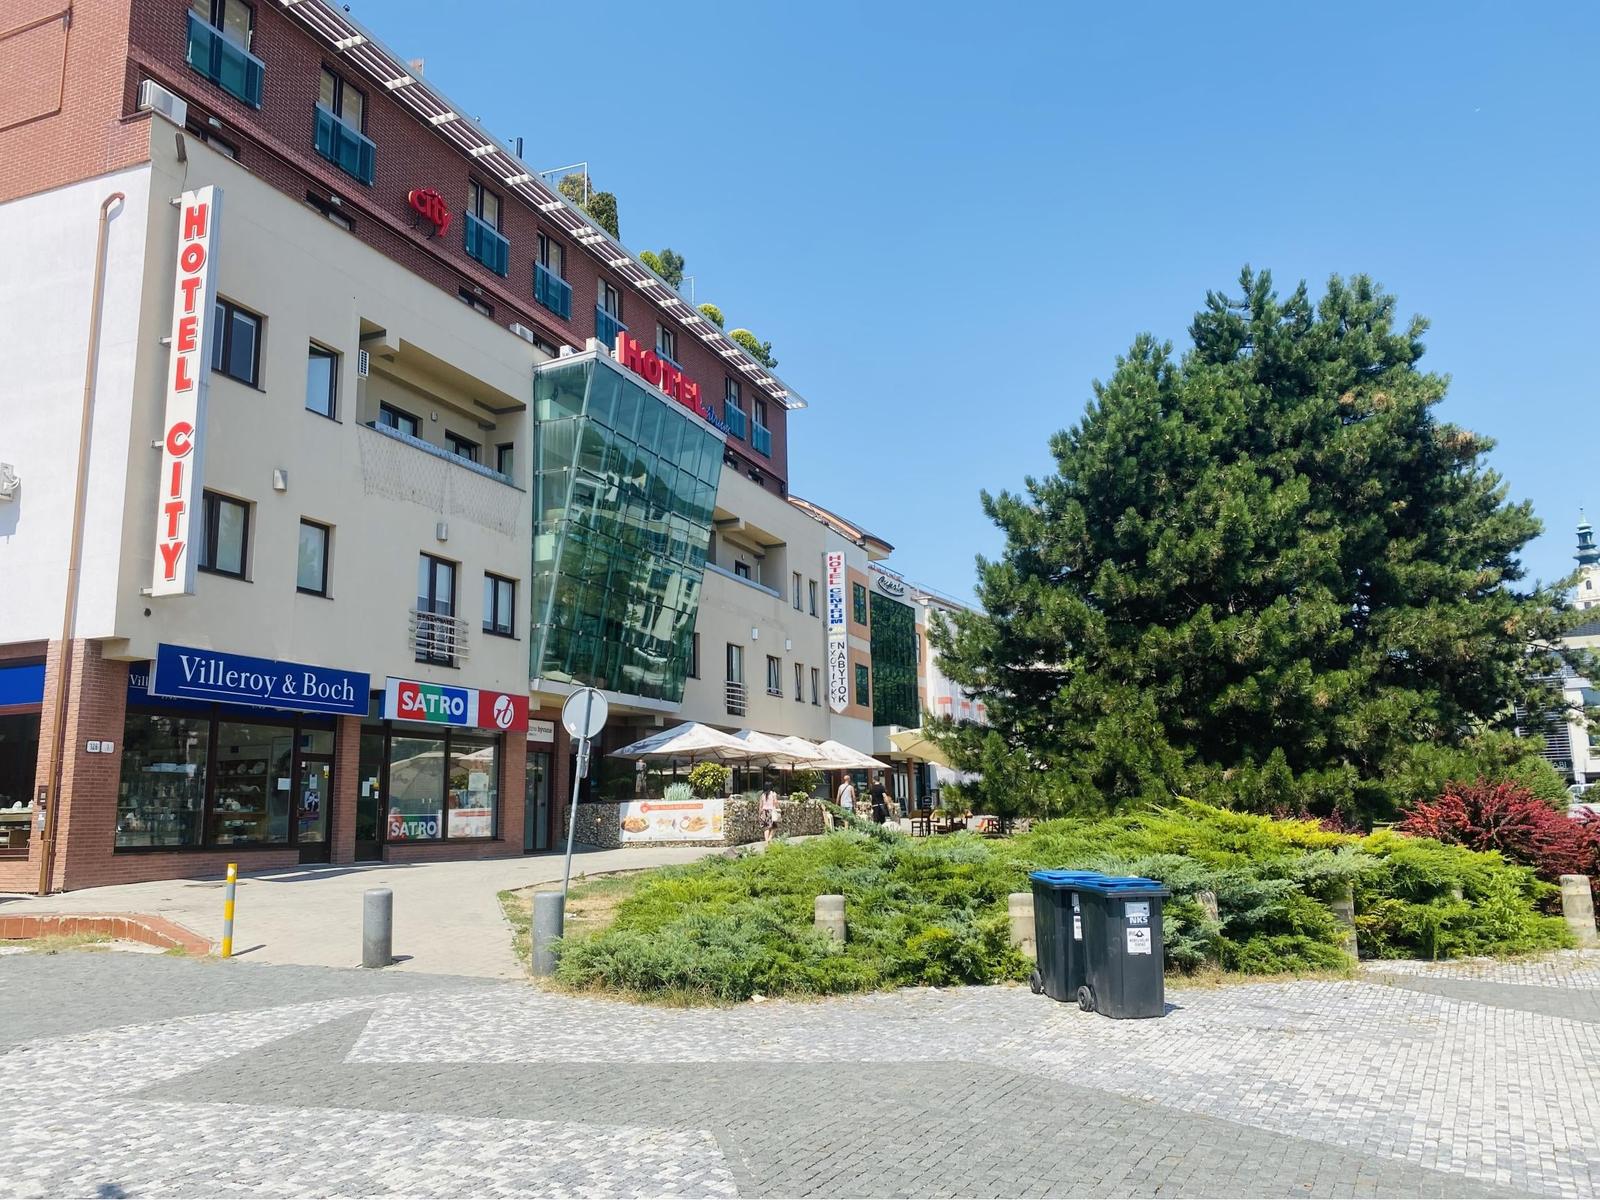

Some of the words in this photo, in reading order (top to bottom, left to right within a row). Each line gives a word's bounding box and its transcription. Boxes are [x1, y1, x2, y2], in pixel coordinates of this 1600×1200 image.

[175, 203, 208, 392] HOTEL
[616, 331, 708, 419] HOTEL
[160, 421, 194, 580] CITY
[829, 555, 841, 585] HOTEL
[829, 587, 843, 624] CENTRUM
[178, 655, 277, 698] Villeroy
[282, 673, 297, 695] &
[301, 672, 355, 701] Boch
[402, 690, 464, 716] SATRO
[391, 821, 437, 836] SATRO
[1130, 916, 1148, 924] NKS
